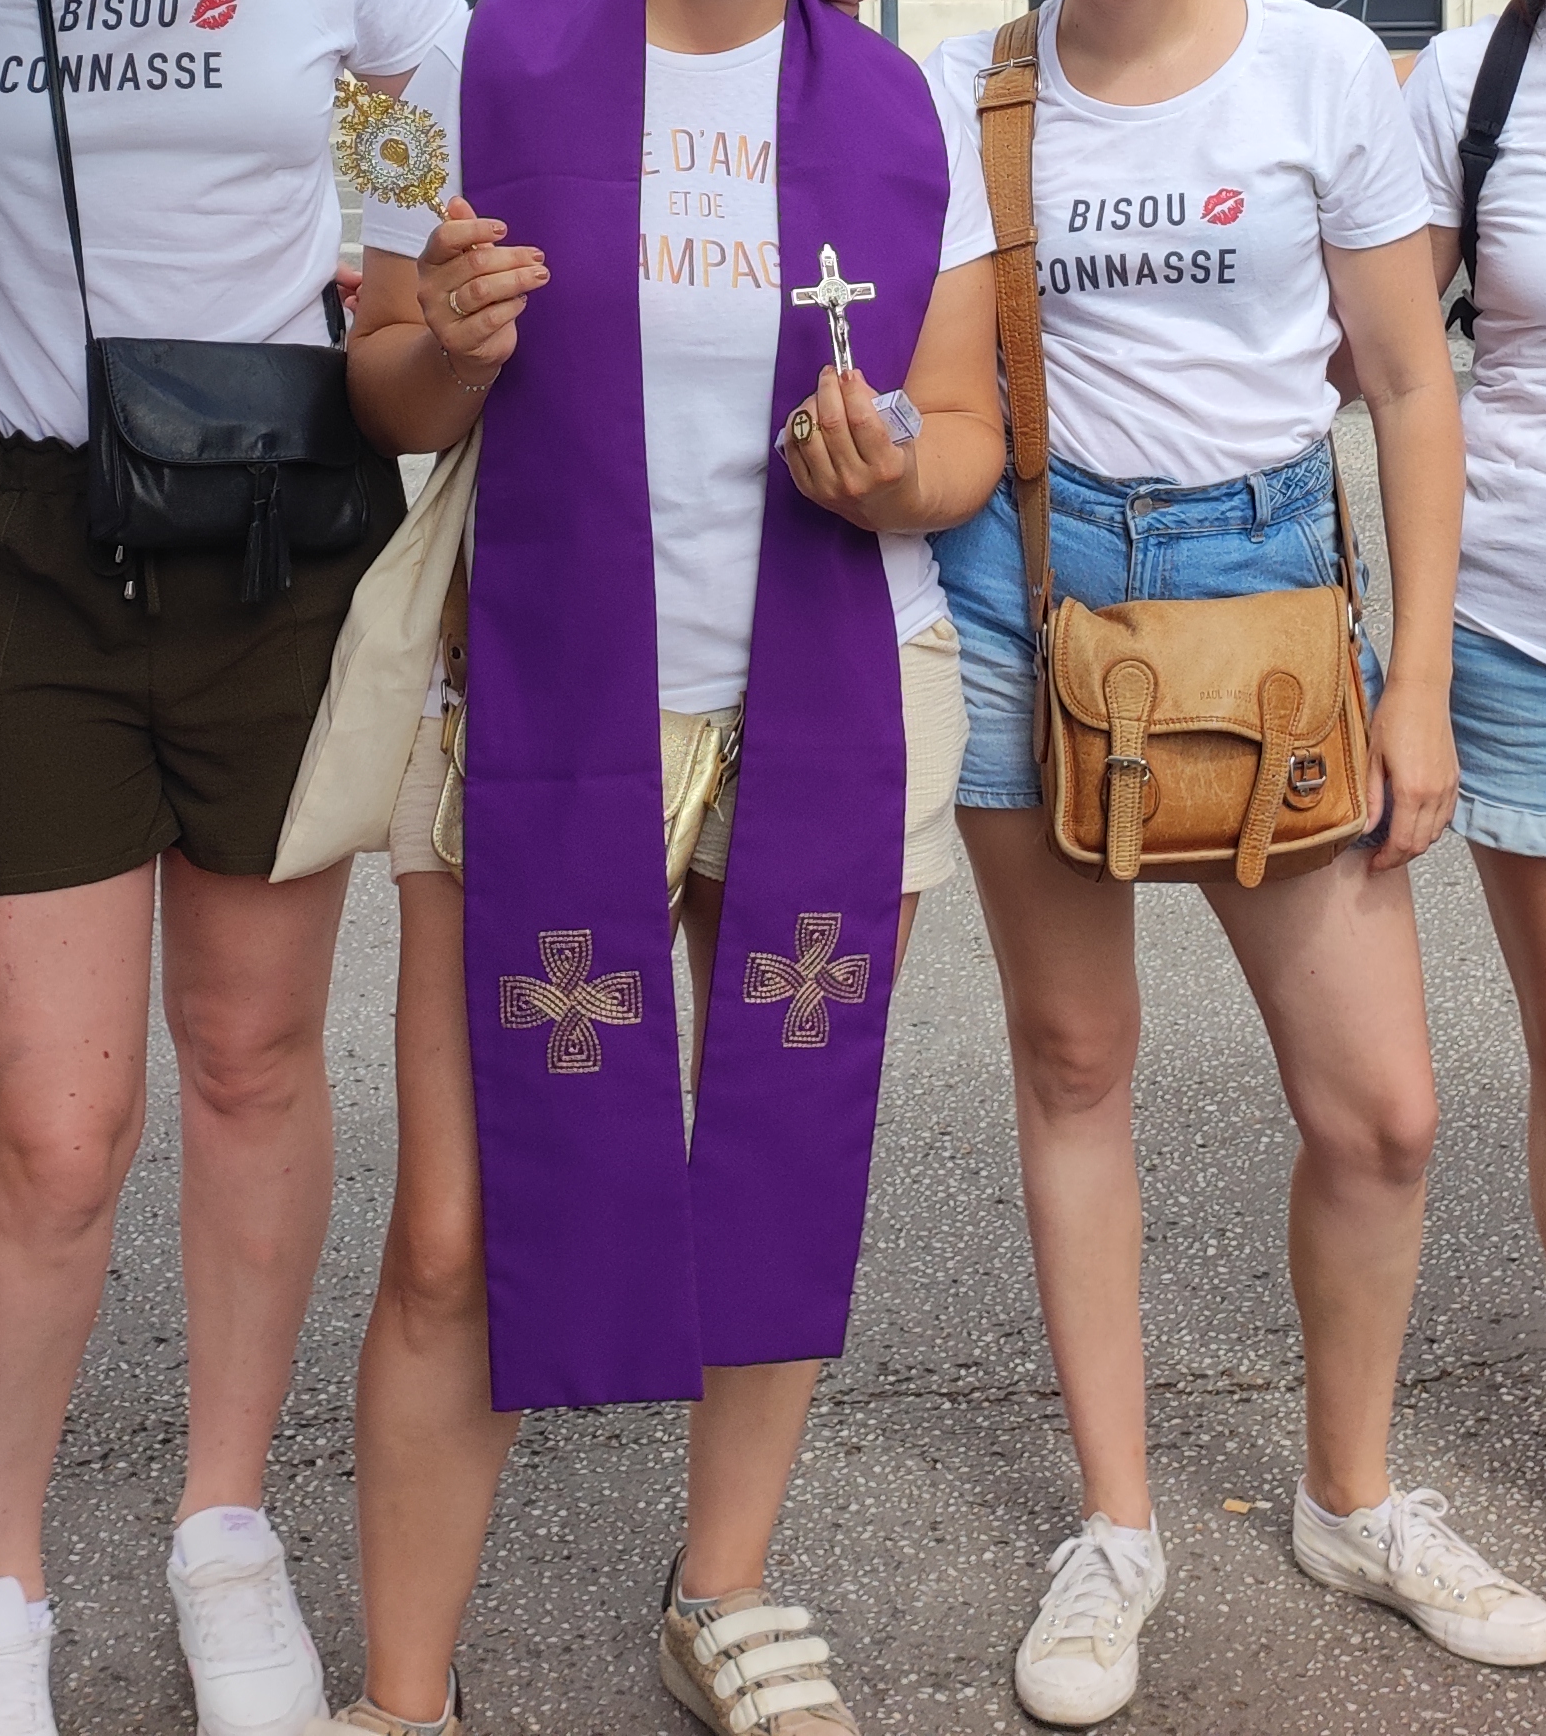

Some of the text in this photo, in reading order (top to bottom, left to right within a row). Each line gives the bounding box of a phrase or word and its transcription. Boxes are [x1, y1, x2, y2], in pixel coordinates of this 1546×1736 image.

[670, 128, 777, 186] D'AM
[669, 190, 725, 219] ET DE
[1068, 192, 1186, 233] BISOU
[1200, 689, 1223, 701] PAUL
